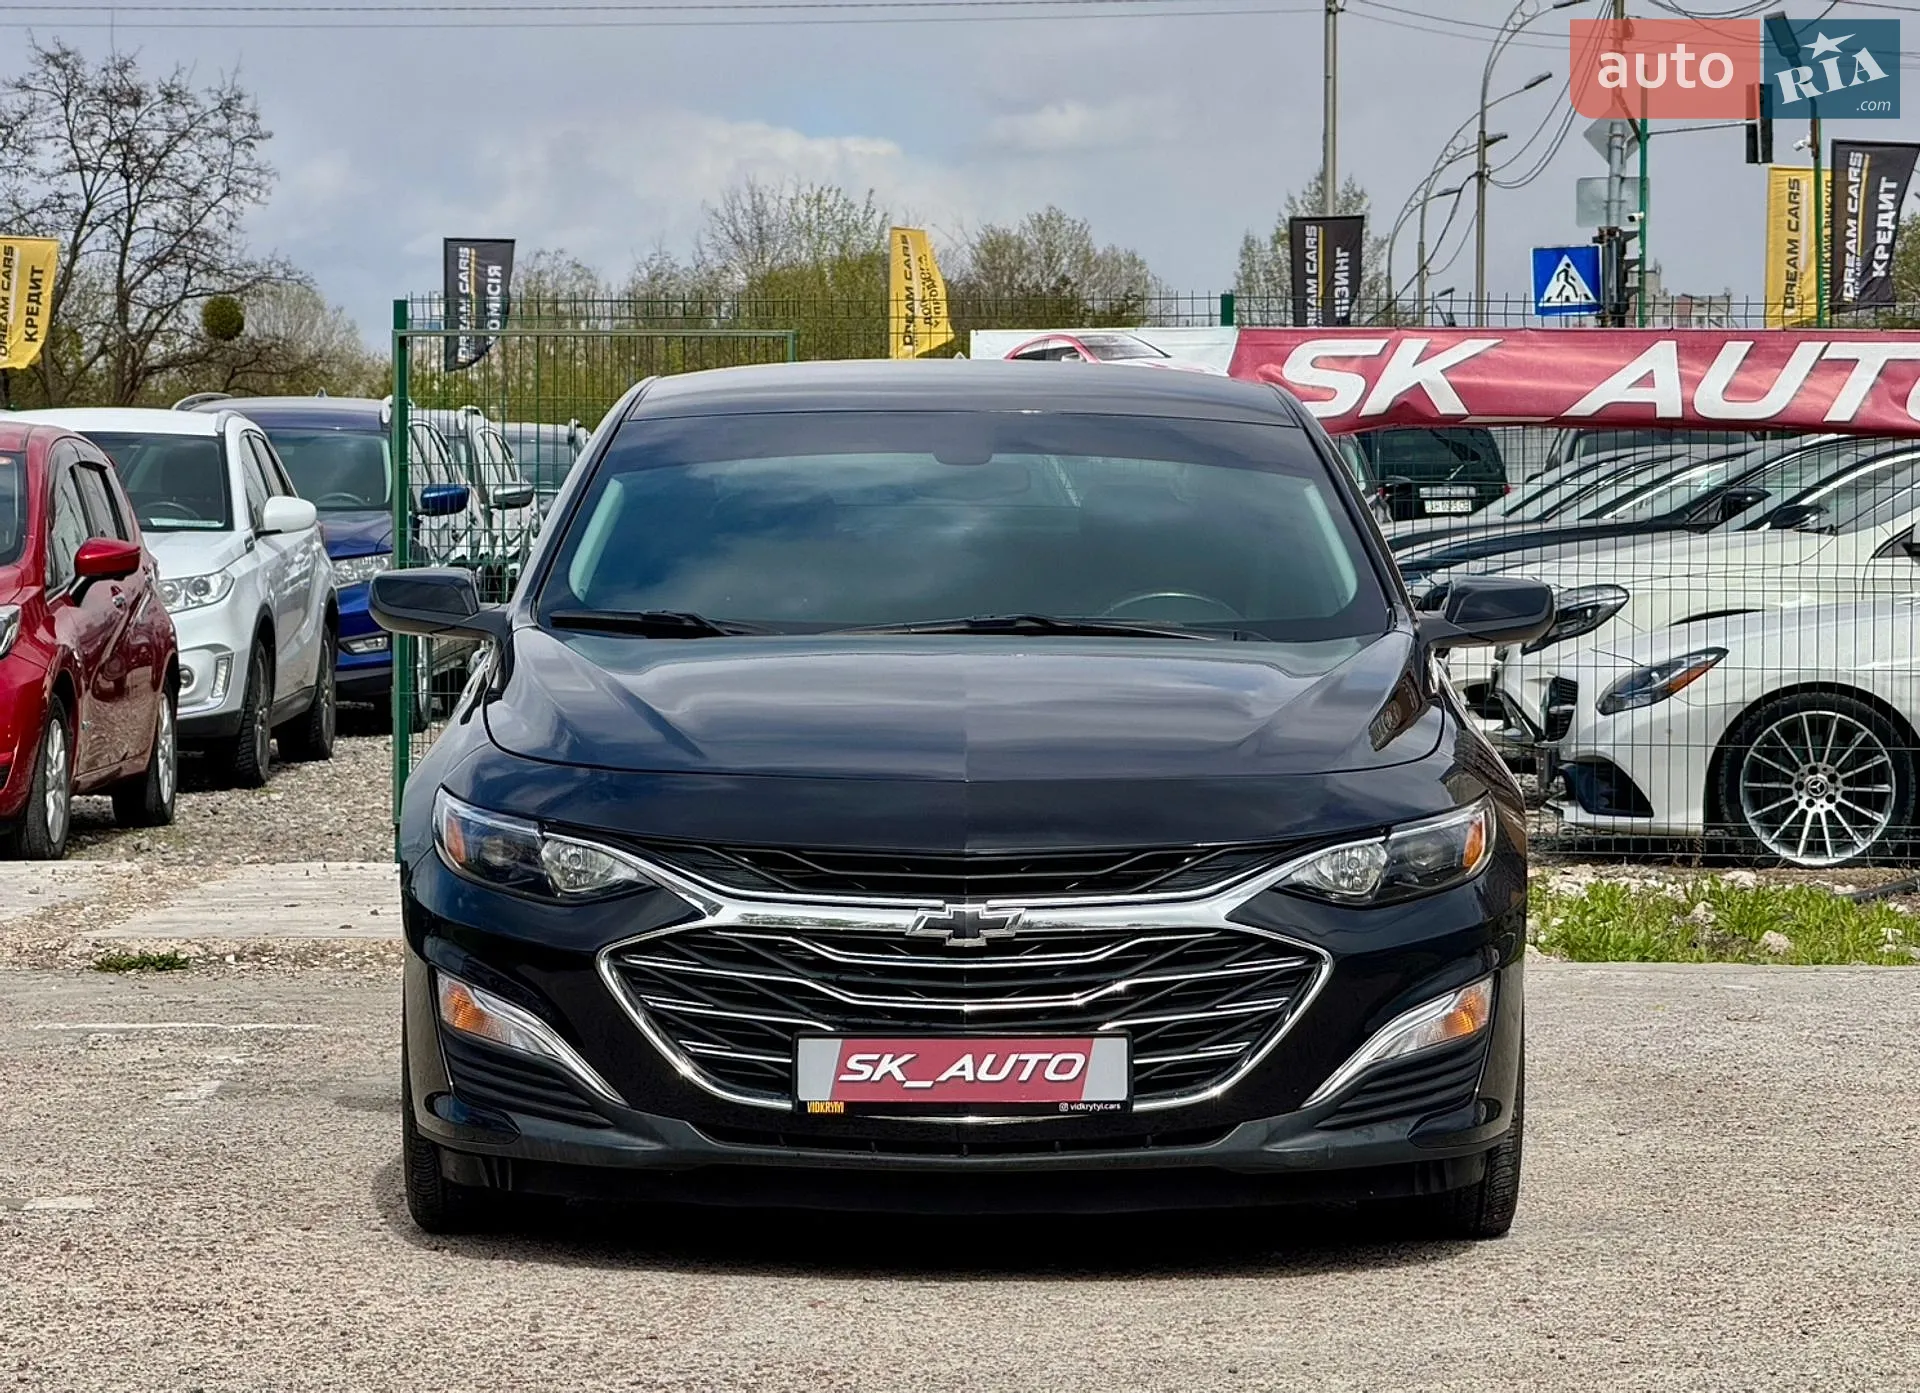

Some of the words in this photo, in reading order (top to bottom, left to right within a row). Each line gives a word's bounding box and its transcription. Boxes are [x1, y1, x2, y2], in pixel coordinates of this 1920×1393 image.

[1787, 177, 1800, 232] CARS
[1847, 152, 1863, 213] CARS
[1305, 225, 1317, 274] CARS
[1872, 176, 1898, 277] КРЕДИТ
[2, 245, 14, 291] CARS
[458, 247, 471, 294] CARS
[901, 234, 913, 281] CARS
[1784, 239, 1799, 309] DREAM
[1842, 221, 1859, 301] DREAM
[24, 265, 44, 343] КРЕДИТ
[457, 298, 471, 361] DREAM
[903, 286, 915, 347] DREAM
[1306, 278, 1318, 327] REAM
[1282, 338, 1920, 423] SK_AUT
[838, 1053, 1087, 1089] SK_AUTO
